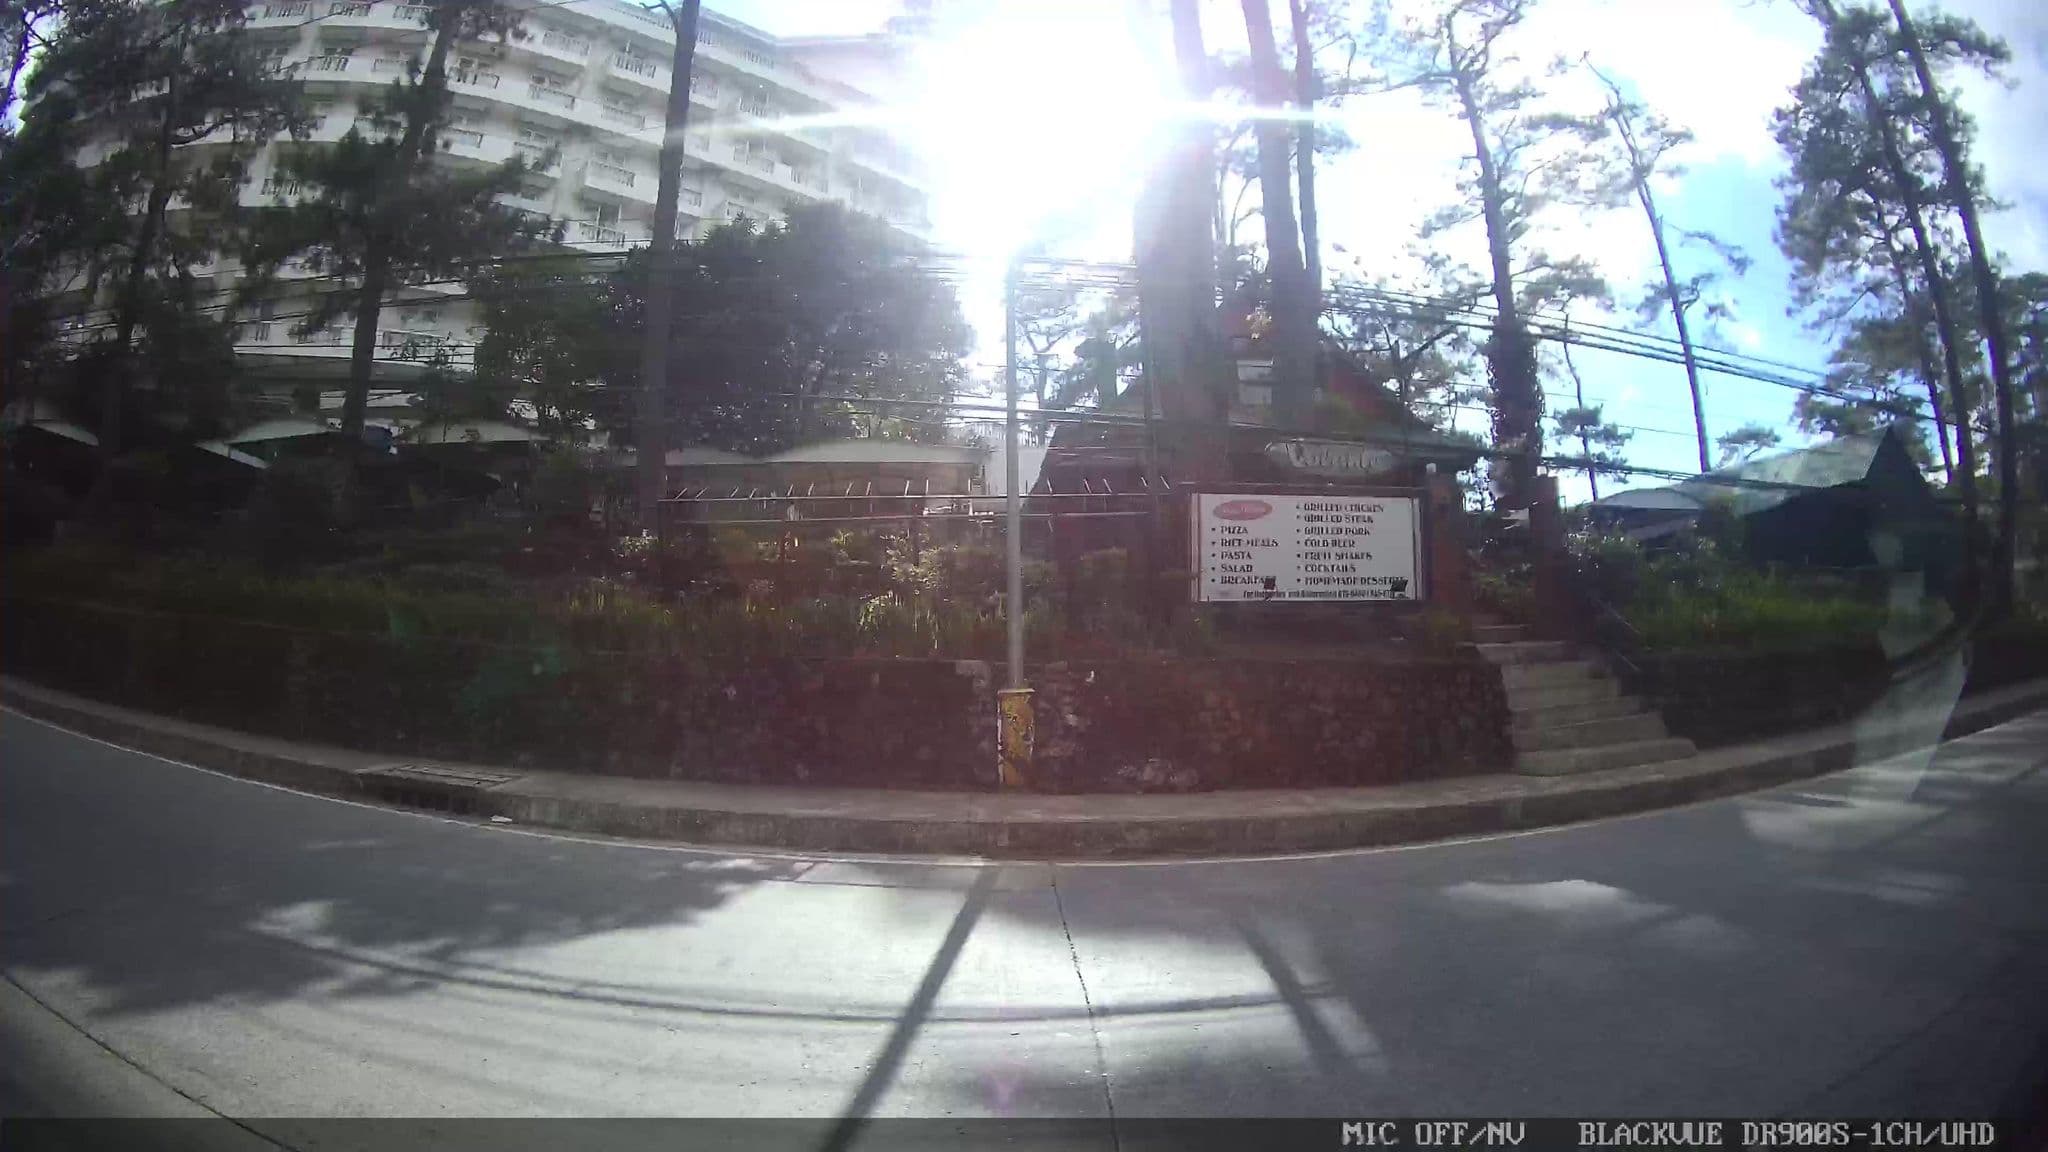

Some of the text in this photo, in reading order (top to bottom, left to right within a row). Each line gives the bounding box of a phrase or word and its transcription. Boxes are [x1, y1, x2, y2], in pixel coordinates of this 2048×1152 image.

[1304, 503, 1342, 512] GRILLED
[1304, 514, 1342, 523] GRILLED
[1220, 525, 1248, 534] PIZZA
[1304, 526, 1370, 536] GRILLED PORK
[1304, 539, 1355, 548] COLD BEER
[1221, 551, 1252, 560] PASTA
[1304, 551, 1372, 560] FRUIT SHAKES
[1221, 564, 1253, 573] SALAD
[1304, 564, 1356, 573] COCKTAILS
[1221, 576, 1276, 585] BREAKFA
